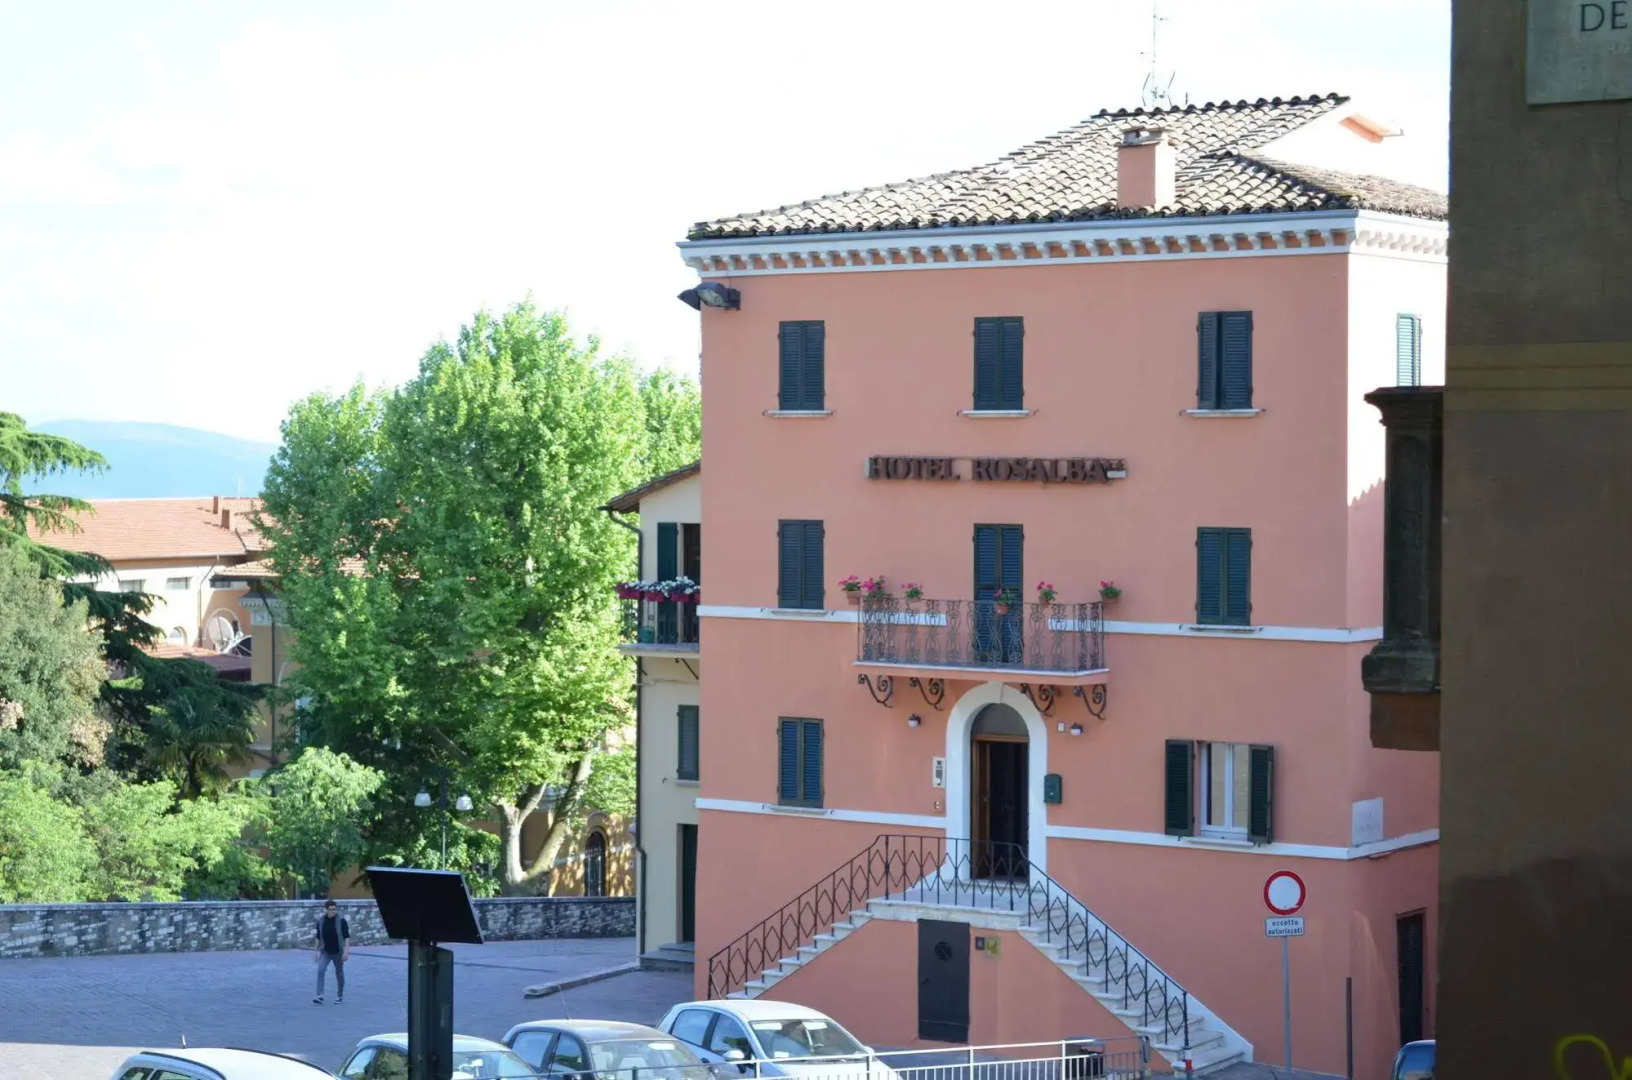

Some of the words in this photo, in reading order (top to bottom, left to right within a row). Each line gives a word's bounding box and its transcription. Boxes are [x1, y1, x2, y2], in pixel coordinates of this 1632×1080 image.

[865, 456, 961, 480] HOTEL
[972, 458, 1109, 483] ROSALBA
[1271, 919, 1299, 927] eccetto
[1267, 927, 1303, 935] autorizzati
